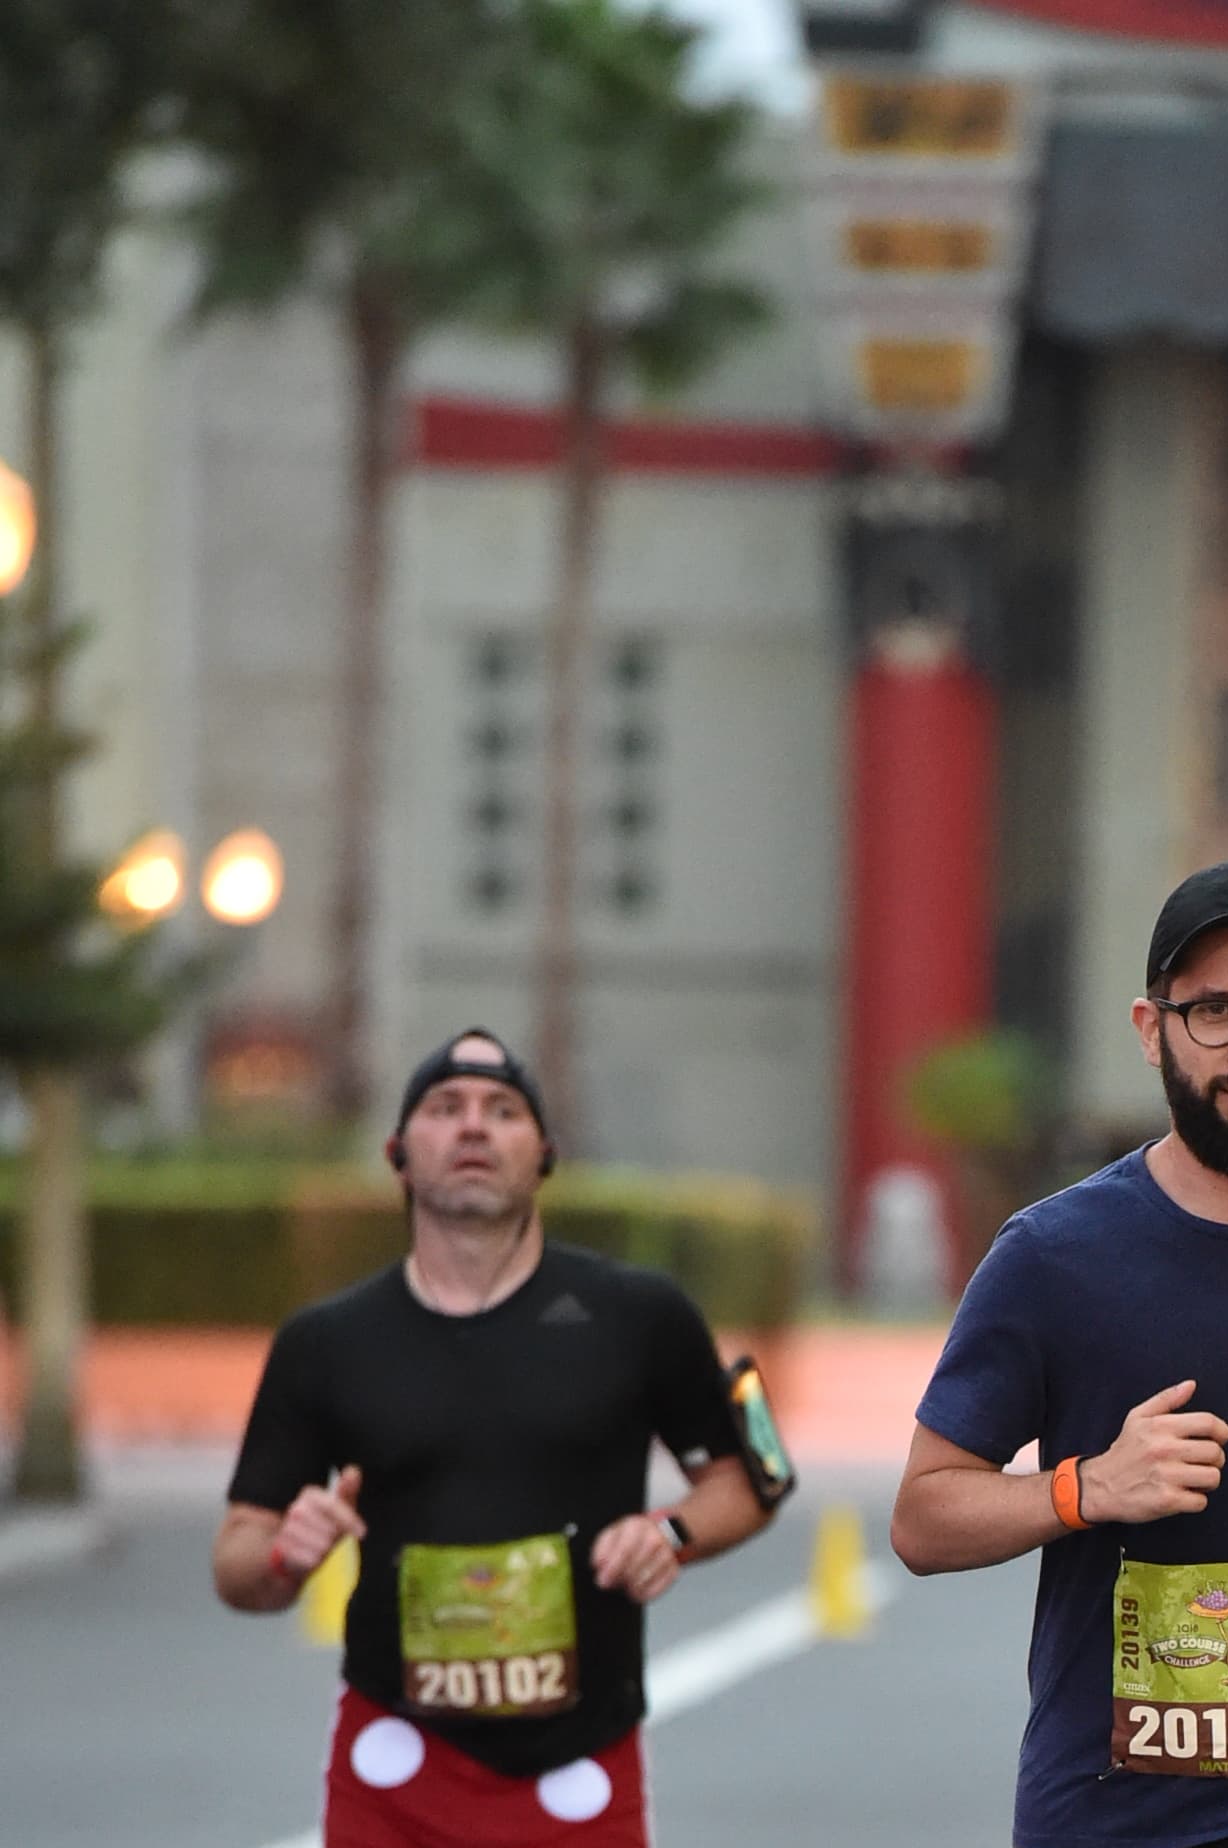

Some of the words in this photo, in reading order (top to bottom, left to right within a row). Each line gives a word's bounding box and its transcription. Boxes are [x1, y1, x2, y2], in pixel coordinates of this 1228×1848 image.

[1121, 1598, 1140, 1671] 20139
[1152, 1639, 1178, 1653] TWO
[1179, 1637, 1227, 1653] COURSE
[1164, 1654, 1211, 1667] CHALLENGE
[414, 1652, 568, 1709] 20102
